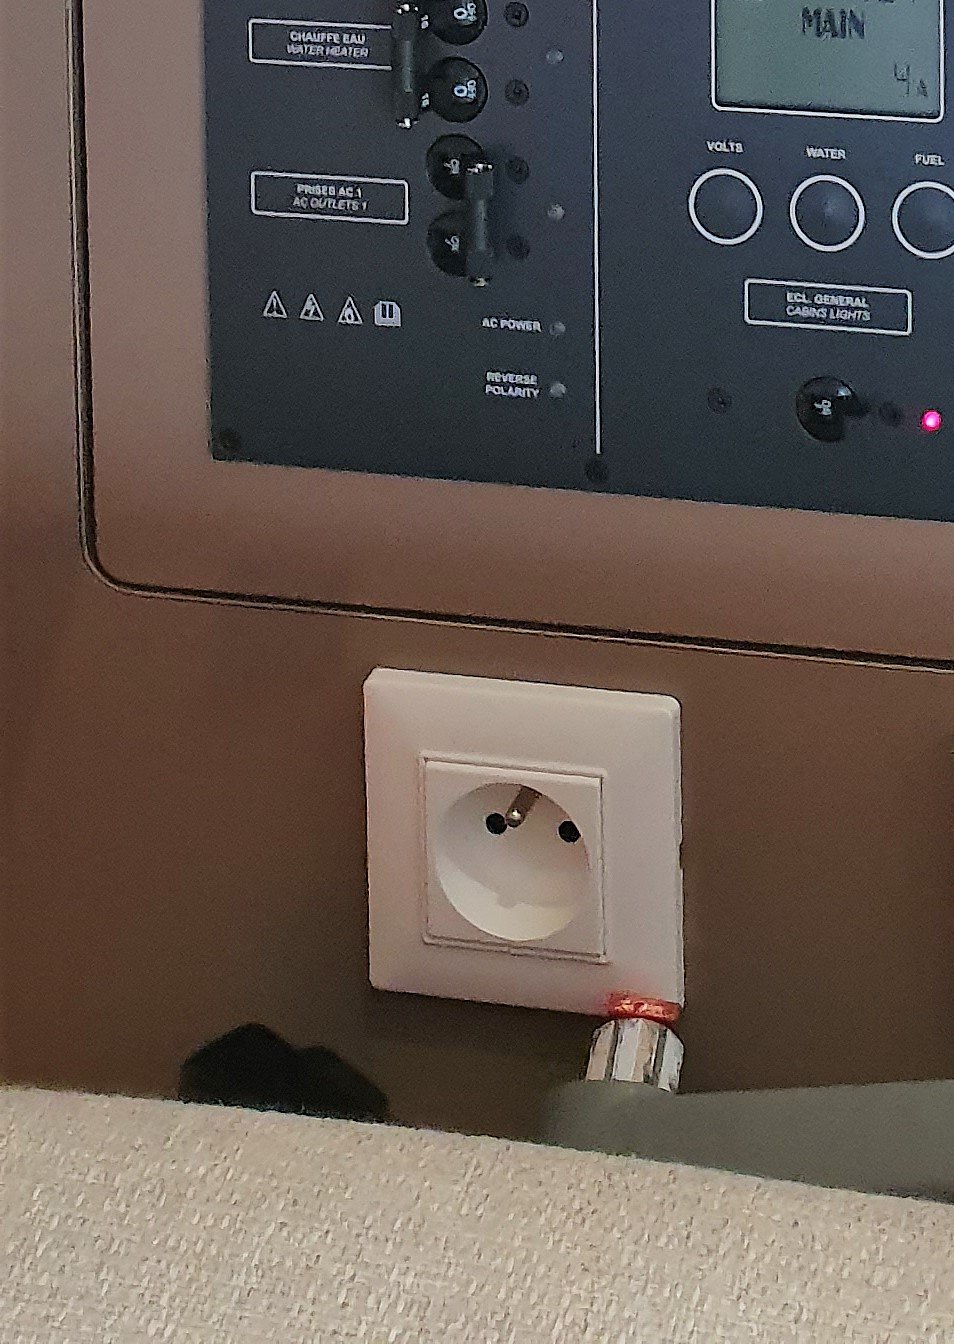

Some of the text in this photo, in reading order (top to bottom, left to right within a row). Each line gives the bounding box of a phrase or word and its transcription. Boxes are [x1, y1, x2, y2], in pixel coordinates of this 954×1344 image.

[802, 6, 865, 40] MAIN
[706, 140, 744, 153] VOLTS
[806, 146, 847, 159] WATER
[915, 153, 945, 166] FUEL
[814, 294, 870, 308] GENERAL
[829, 308, 871, 321] LIGHTS
[481, 316, 543, 333] AC POWER
[485, 384, 540, 399] POLARITY
